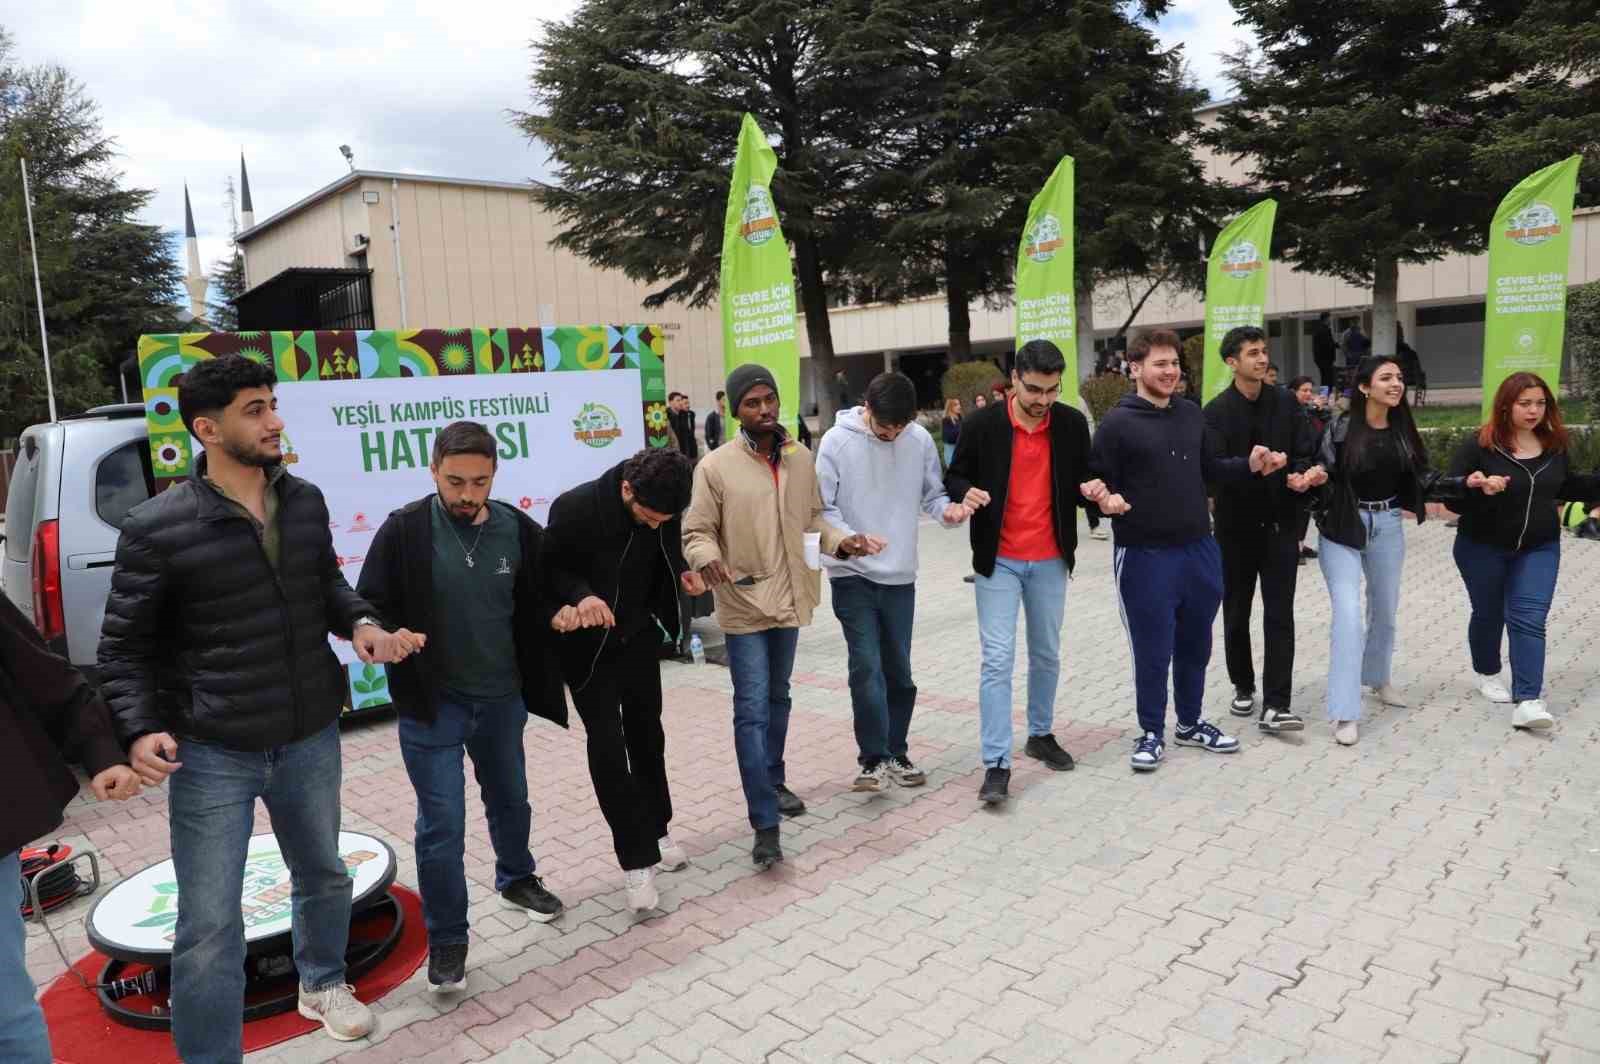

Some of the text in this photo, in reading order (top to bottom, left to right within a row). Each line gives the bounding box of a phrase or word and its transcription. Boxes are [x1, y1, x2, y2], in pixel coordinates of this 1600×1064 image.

[332, 391, 550, 428] YEŞİL KAMPÜS FESTİVALİ
[360, 420, 529, 473] HATSI
